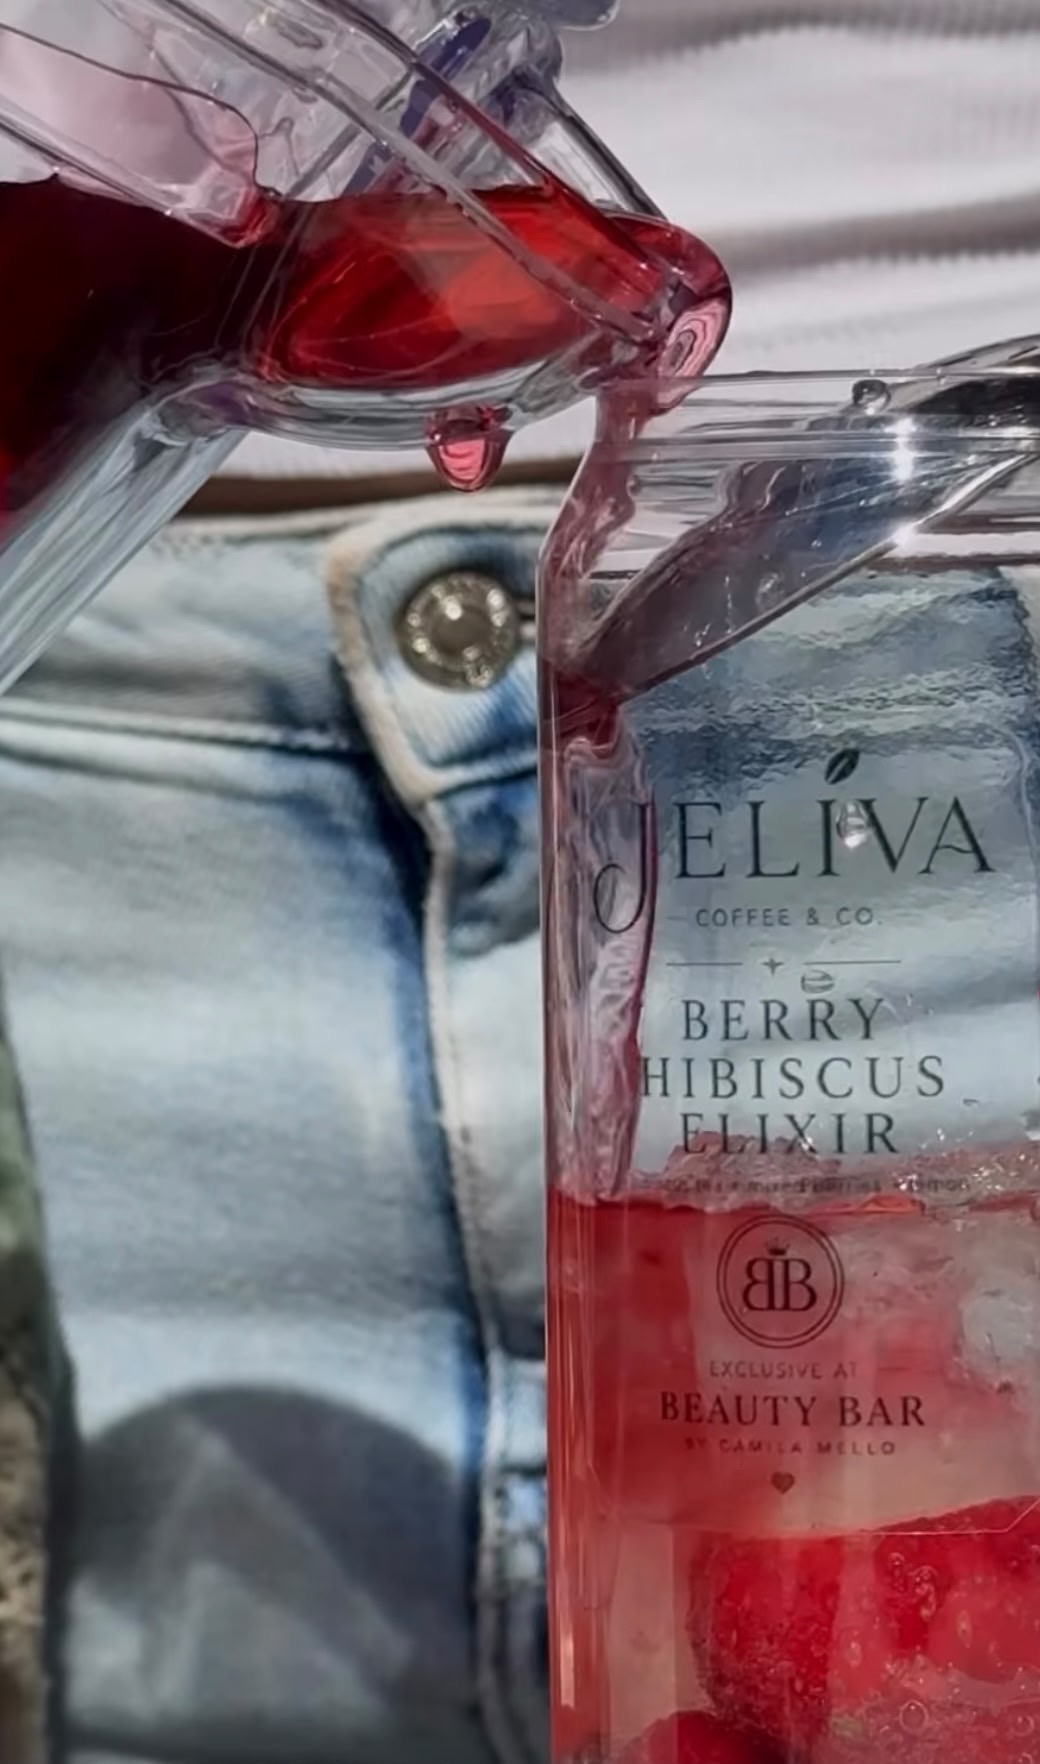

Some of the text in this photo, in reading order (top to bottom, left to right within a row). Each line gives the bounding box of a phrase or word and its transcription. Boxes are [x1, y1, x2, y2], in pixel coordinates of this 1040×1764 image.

[593, 797, 996, 934] JELIVA
[696, 907, 883, 927] COFFEE & CO.
[683, 999, 884, 1041] BERRY
[642, 1056, 945, 1098] HIBISCUS
[680, 1113, 899, 1154] ELIXIR
[709, 1360, 858, 1379] EXCLUSIVE AT
[660, 1391, 926, 1427] BEAUTY BAR
[719, 1438, 801, 1455] CAMILA
[817, 1440, 896, 1456] MELLO
